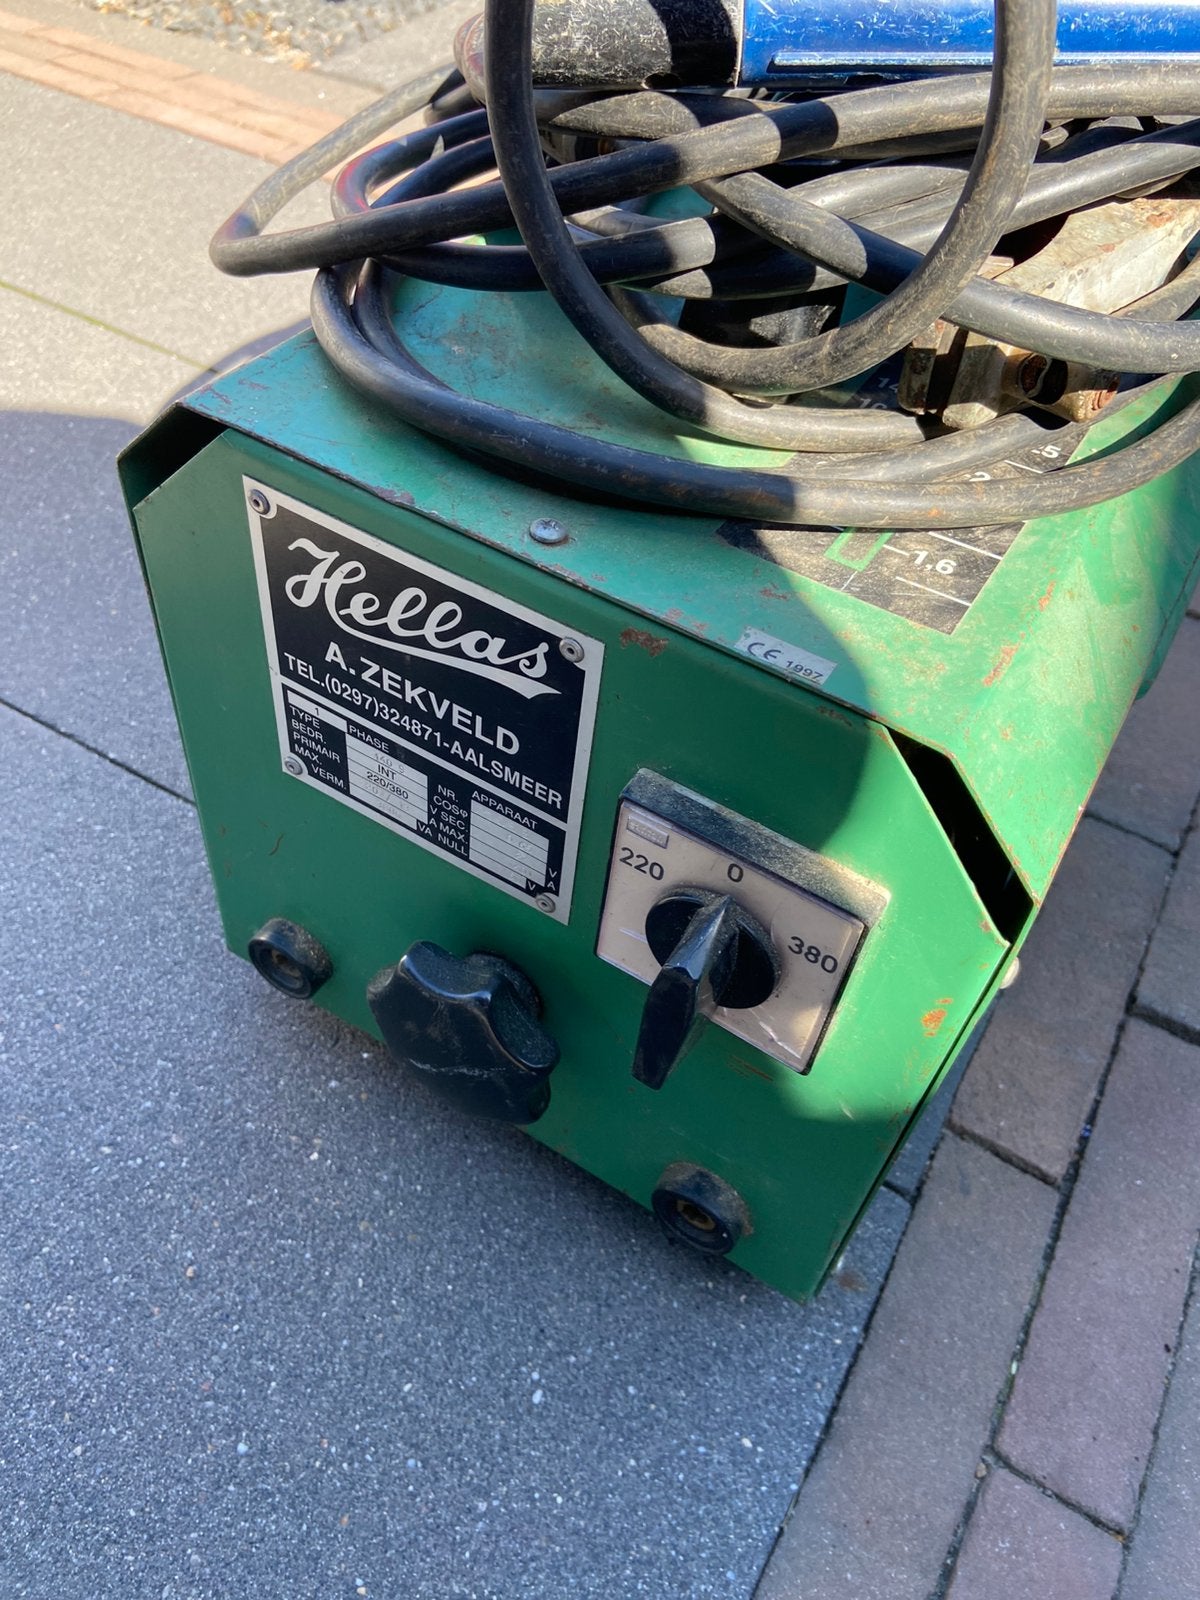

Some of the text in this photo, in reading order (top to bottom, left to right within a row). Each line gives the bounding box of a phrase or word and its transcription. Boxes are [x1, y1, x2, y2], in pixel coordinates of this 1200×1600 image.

[913, 549, 957, 575] 1,6
[285, 537, 553, 682] Hellas
[785, 659, 824, 681] 1997
[289, 704, 321, 729] TYPE
[291, 718, 397, 781] BEDR. INT
[349, 724, 390, 754] PHASE
[293, 731, 341, 764] PRIMAIR
[366, 770, 409, 800] 220/380
[294, 743, 323, 766] MAX.
[310, 763, 347, 790] VERM.
[437, 784, 459, 803] NR.
[471, 789, 539, 831] APPARAAT
[439, 821, 469, 845] MAX.
[440, 810, 469, 833] SEC.
[417, 821, 469, 857] VA NULL
[548, 867, 558, 878] V
[619, 846, 665, 881] 220
[727, 863, 744, 883] 0
[527, 880, 536, 891] V
[546, 880, 556, 891] A
[787, 935, 839, 975] 380
